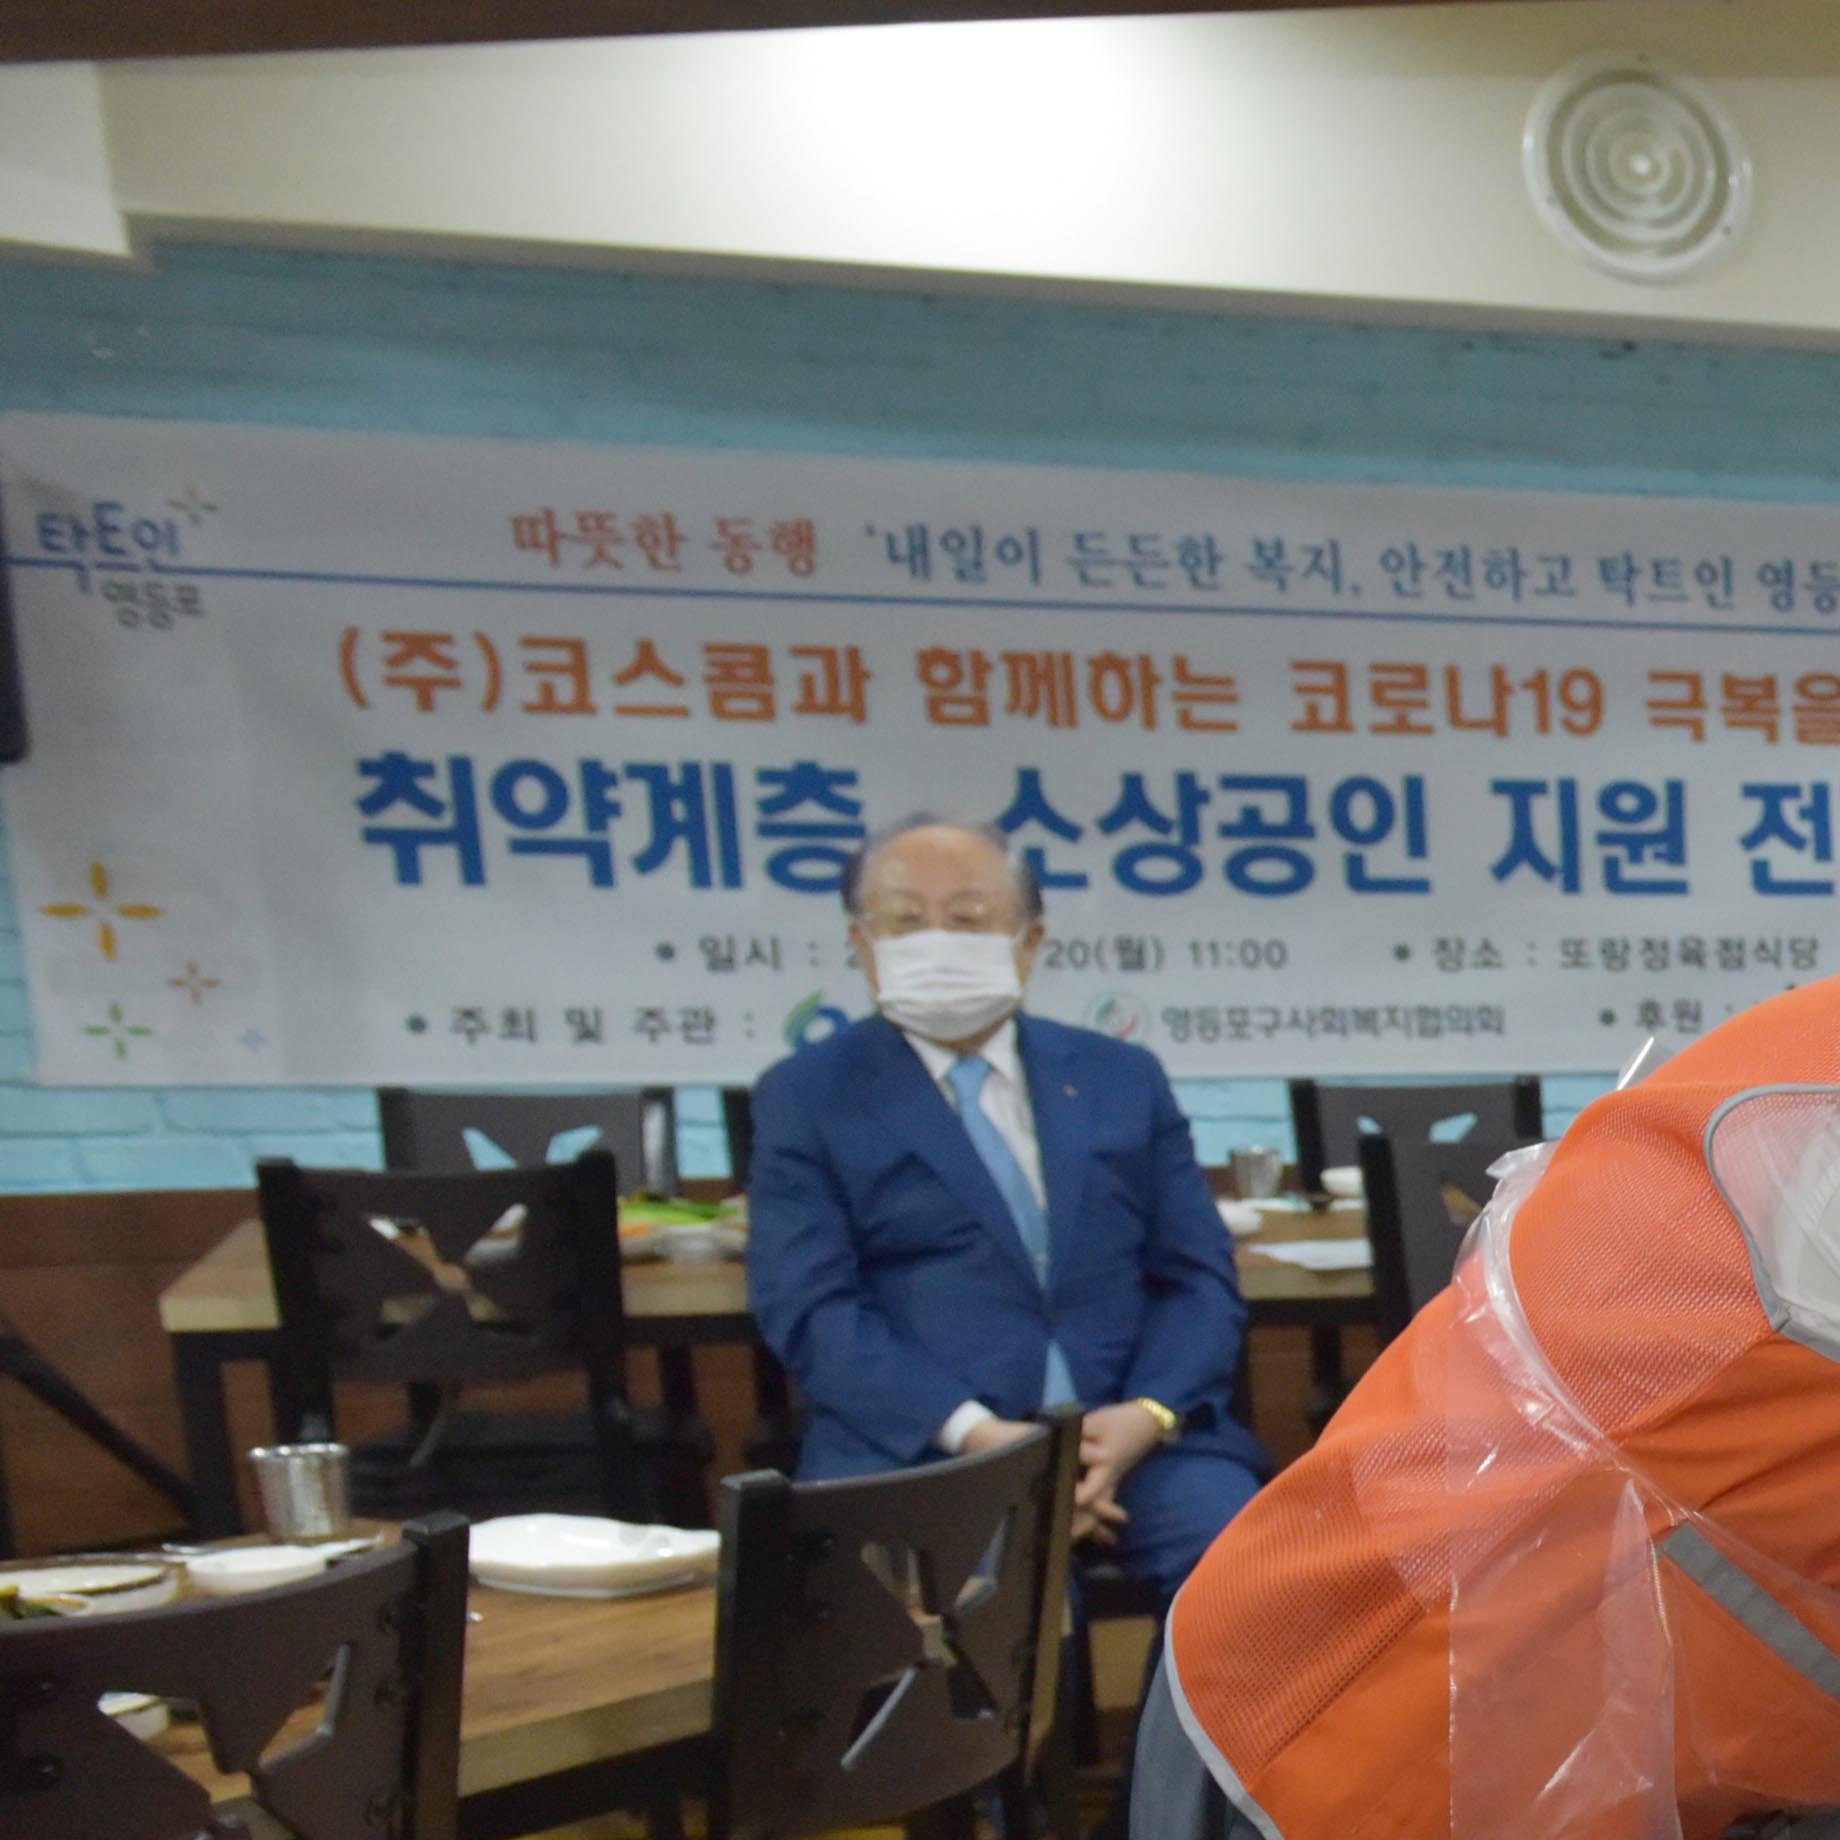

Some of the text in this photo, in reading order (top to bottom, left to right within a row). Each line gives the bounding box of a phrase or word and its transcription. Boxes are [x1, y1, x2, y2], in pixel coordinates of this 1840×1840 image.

[511, 508, 688, 572] 따뜻한
[710, 517, 819, 578] 동행
[1066, 531, 1224, 590] 든든한
[1380, 543, 1579, 600] 안전하고
[1597, 550, 1736, 609] 탁트인
[103, 579, 207, 630] 영등포
[340, 626, 873, 724] (주)코스콤과
[916, 646, 1240, 733] 함께하는
[1289, 659, 1606, 738] 코로나19
[354, 750, 868, 896] 취약계층
[996, 766, 1433, 897] 소상공인
[1489, 778, 1690, 897] 지원
[698, 933, 782, 971] 일시
[1187, 938, 1289, 970] 11:00
[1432, 936, 1504, 973] 장소
[449, 1005, 538, 1045] 주최
[565, 1005, 603, 1045] 및
[633, 1005, 717, 1046] 주관
[1161, 1006, 1507, 1043] 영등포구사회복지협의회
[1634, 997, 1703, 1033] 후원
